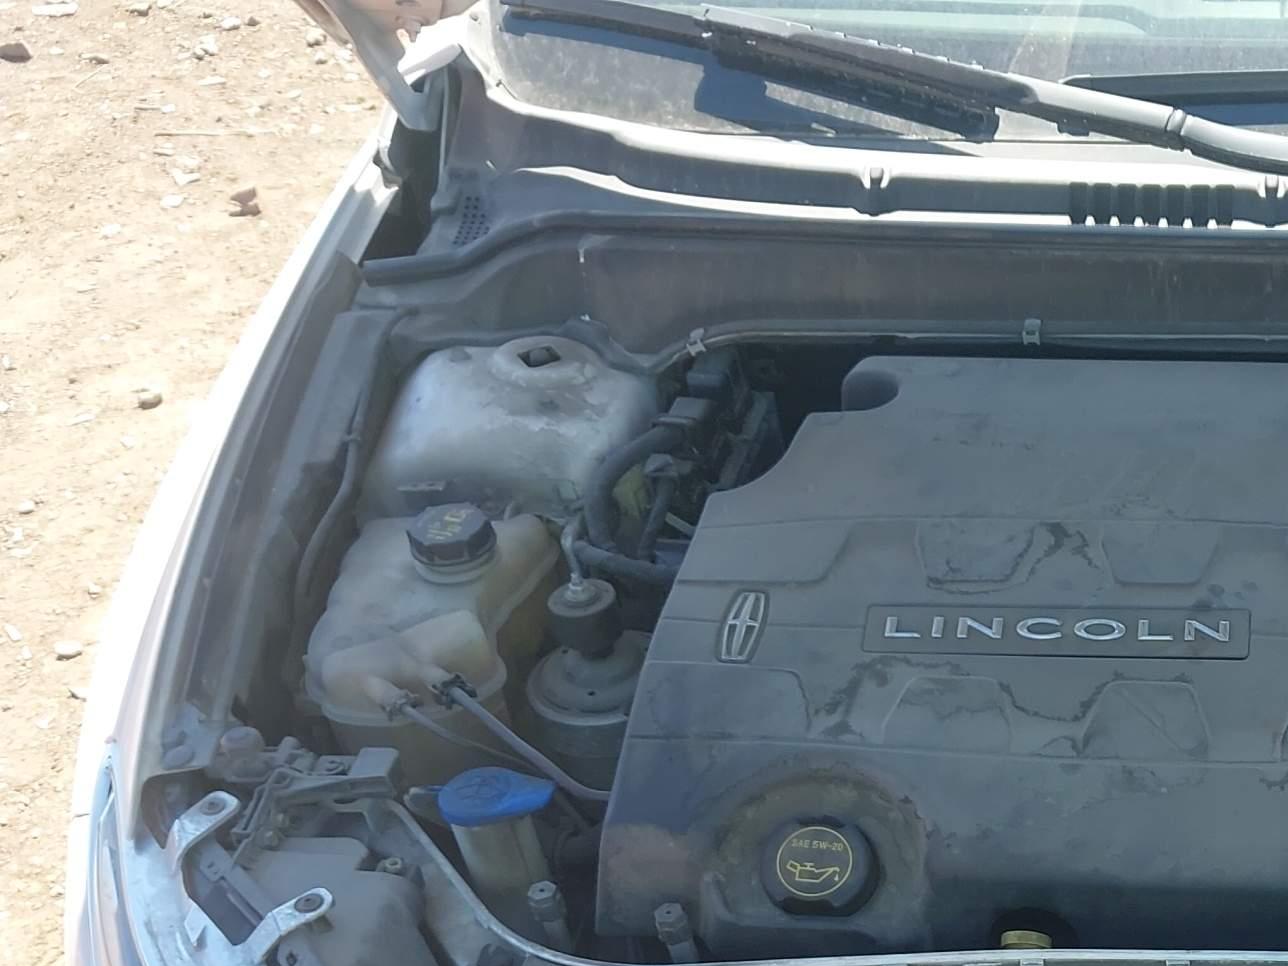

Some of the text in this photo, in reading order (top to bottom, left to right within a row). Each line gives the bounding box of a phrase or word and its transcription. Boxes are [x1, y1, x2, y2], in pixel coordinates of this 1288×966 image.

[884, 616, 1231, 642] LINCOLN
[791, 839, 844, 851] SAE 5W-20
